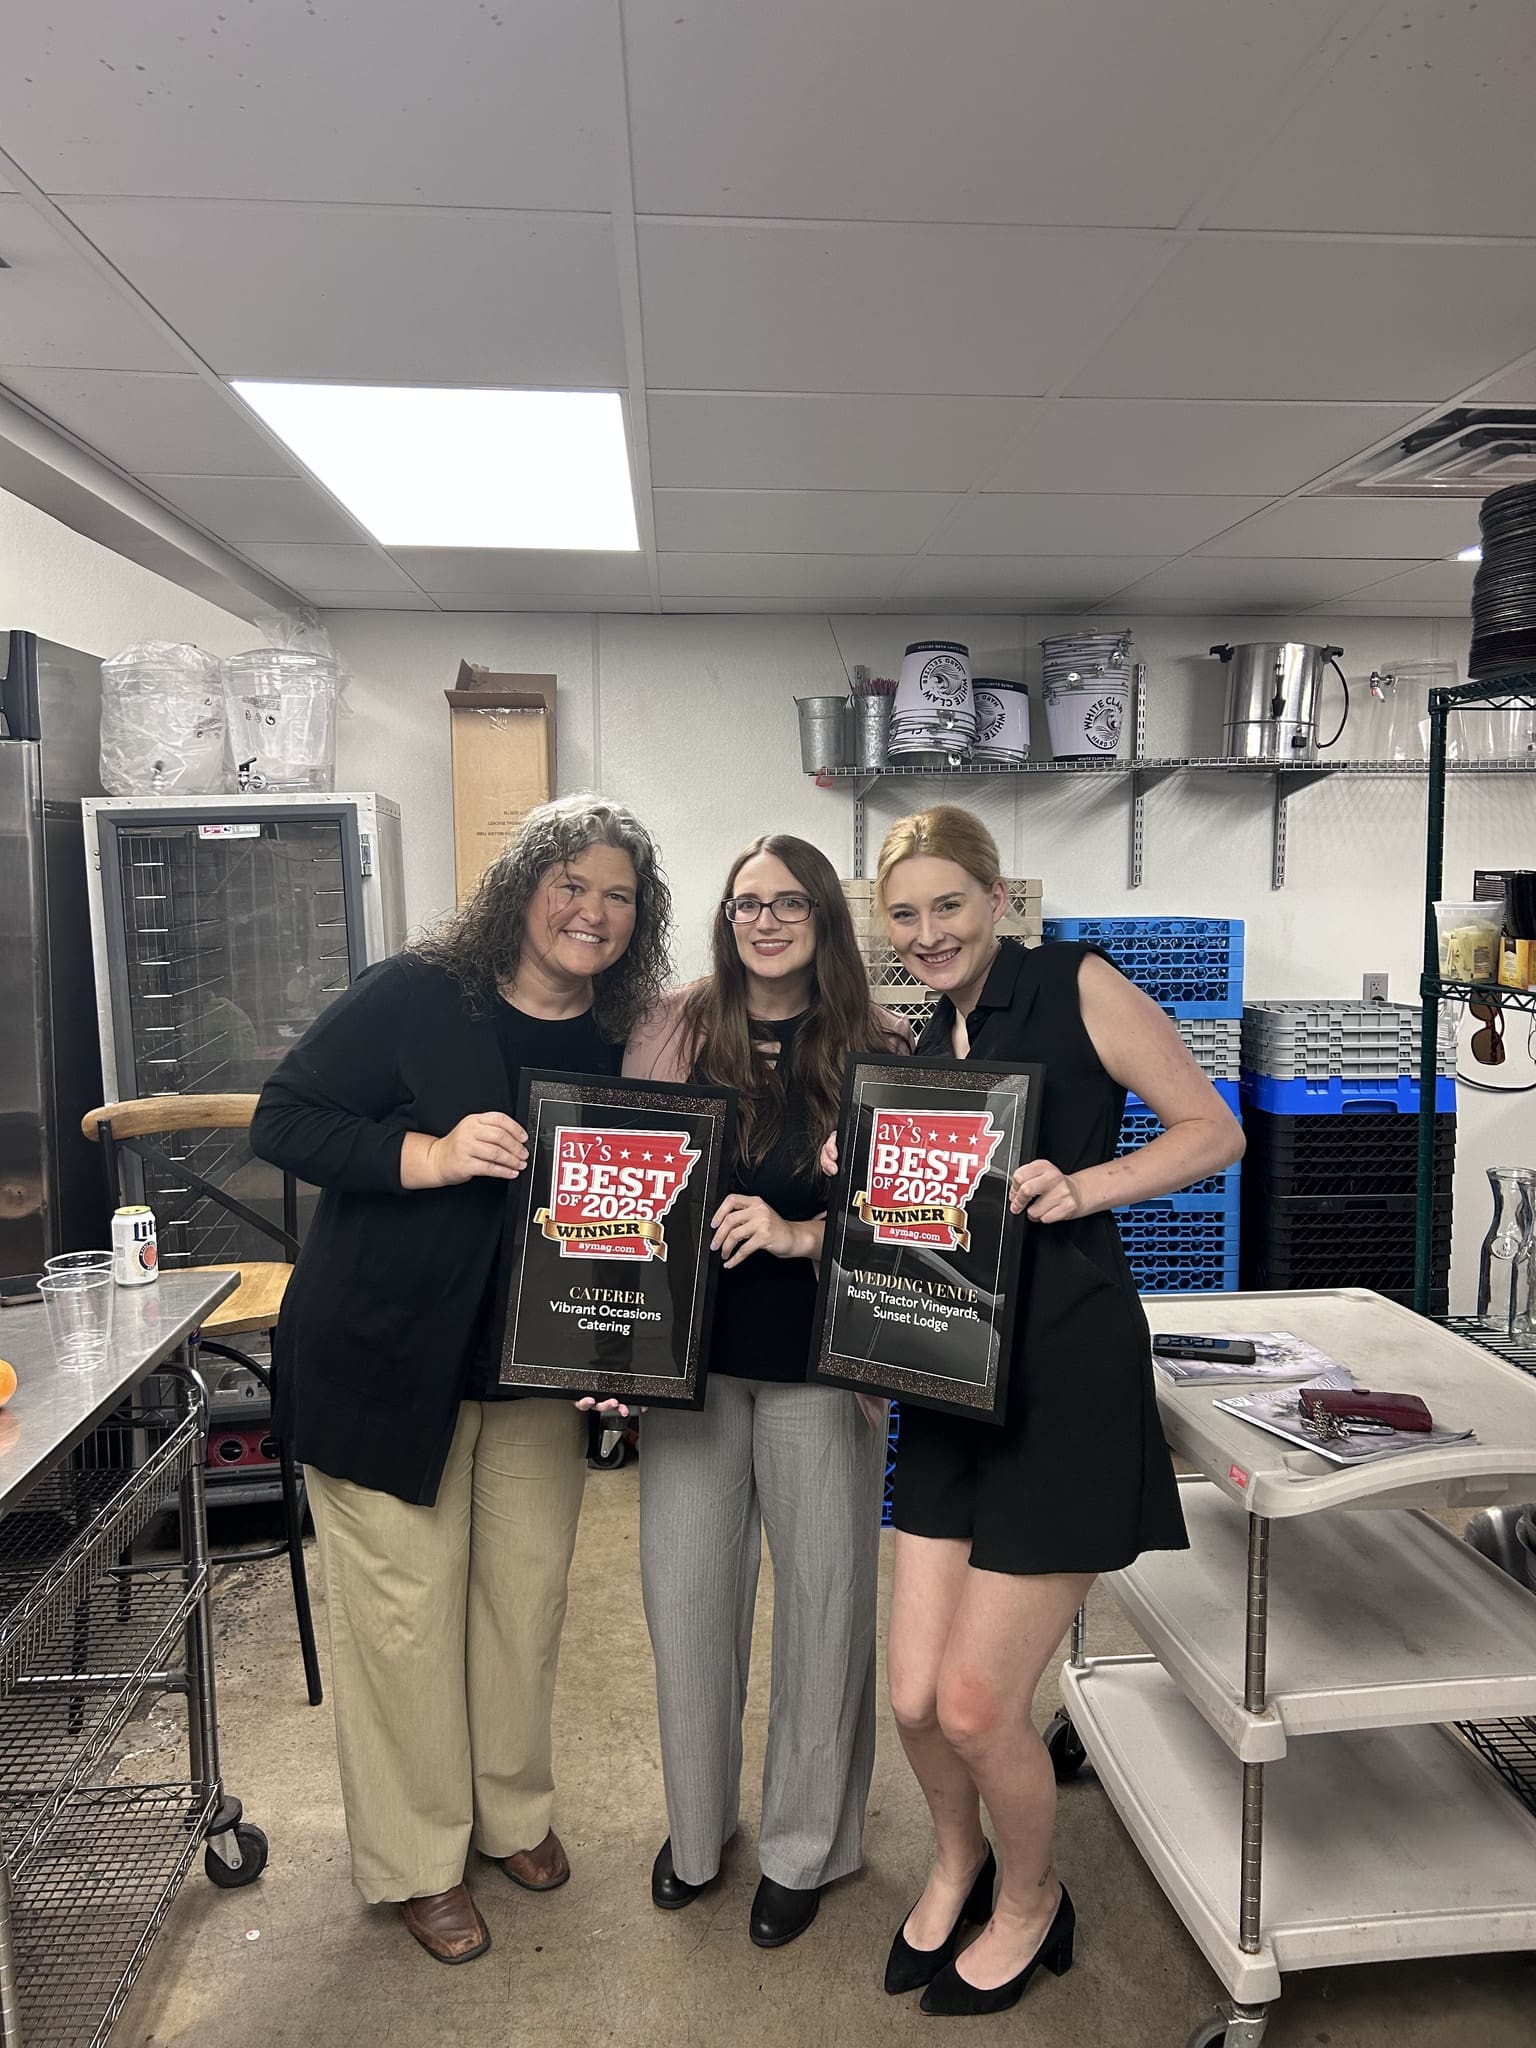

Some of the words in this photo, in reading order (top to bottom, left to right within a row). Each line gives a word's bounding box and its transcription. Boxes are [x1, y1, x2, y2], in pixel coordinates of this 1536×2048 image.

[945, 658, 962, 672] HARD
[922, 690, 953, 707] CLAW
[953, 678, 968, 706] WHITE
[982, 694, 999, 707] HARD
[984, 712, 1006, 741] WHITE
[1084, 699, 1105, 731] WHITE
[1091, 735, 1108, 747] HARD
[878, 1117, 921, 1146] ay's
[562, 1136, 612, 1164] ay's
[874, 1143, 979, 1185] BEST
[559, 1161, 676, 1200] BEST
[873, 1175, 894, 1190] OF
[892, 1177, 958, 1207] 2025
[557, 1192, 582, 1208] OF
[582, 1195, 654, 1221] 2025
[871, 1206, 945, 1224] WINNER
[133, 1220, 157, 1242] Lit
[556, 1223, 641, 1239] WINNER
[889, 1226, 941, 1242] aymag.com
[578, 1241, 635, 1255] aymag.com
[569, 1286, 646, 1305] CATERER
[852, 1269, 923, 1294] WEDDING
[926, 1280, 978, 1304] VENUE
[549, 1300, 597, 1317] Vibrant
[598, 1304, 662, 1321] Occasions
[847, 1285, 877, 1306] Rusty
[879, 1289, 919, 1309] Tractor
[922, 1298, 981, 1323] Vineyards,
[577, 1318, 631, 1336] Catering
[873, 1305, 912, 1325] Sunset
[914, 1313, 949, 1332] Lodge
